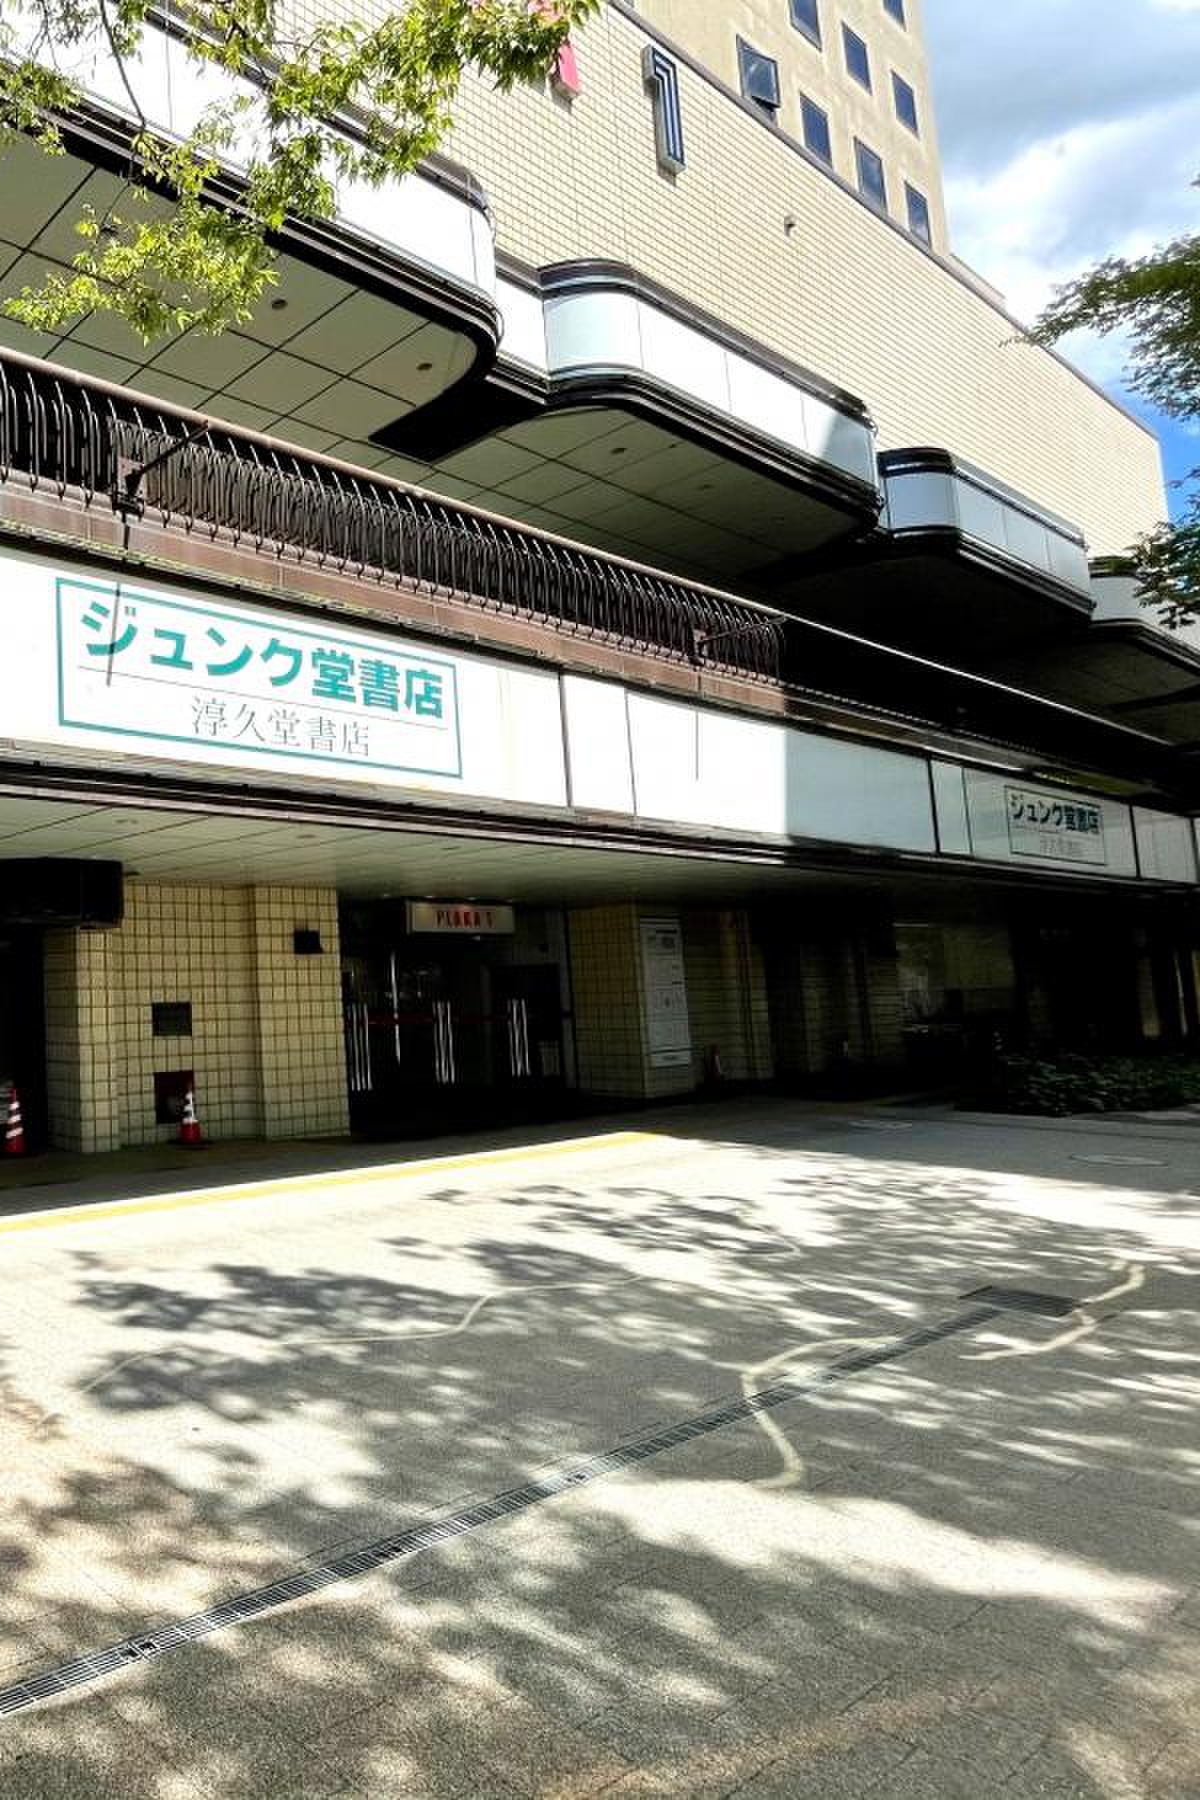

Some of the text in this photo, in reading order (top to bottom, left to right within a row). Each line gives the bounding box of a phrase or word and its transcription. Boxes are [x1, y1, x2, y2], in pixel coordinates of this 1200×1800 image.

[80, 600, 443, 719] ジュンク堂書店
[191, 695, 370, 758] 淳久堂書店
